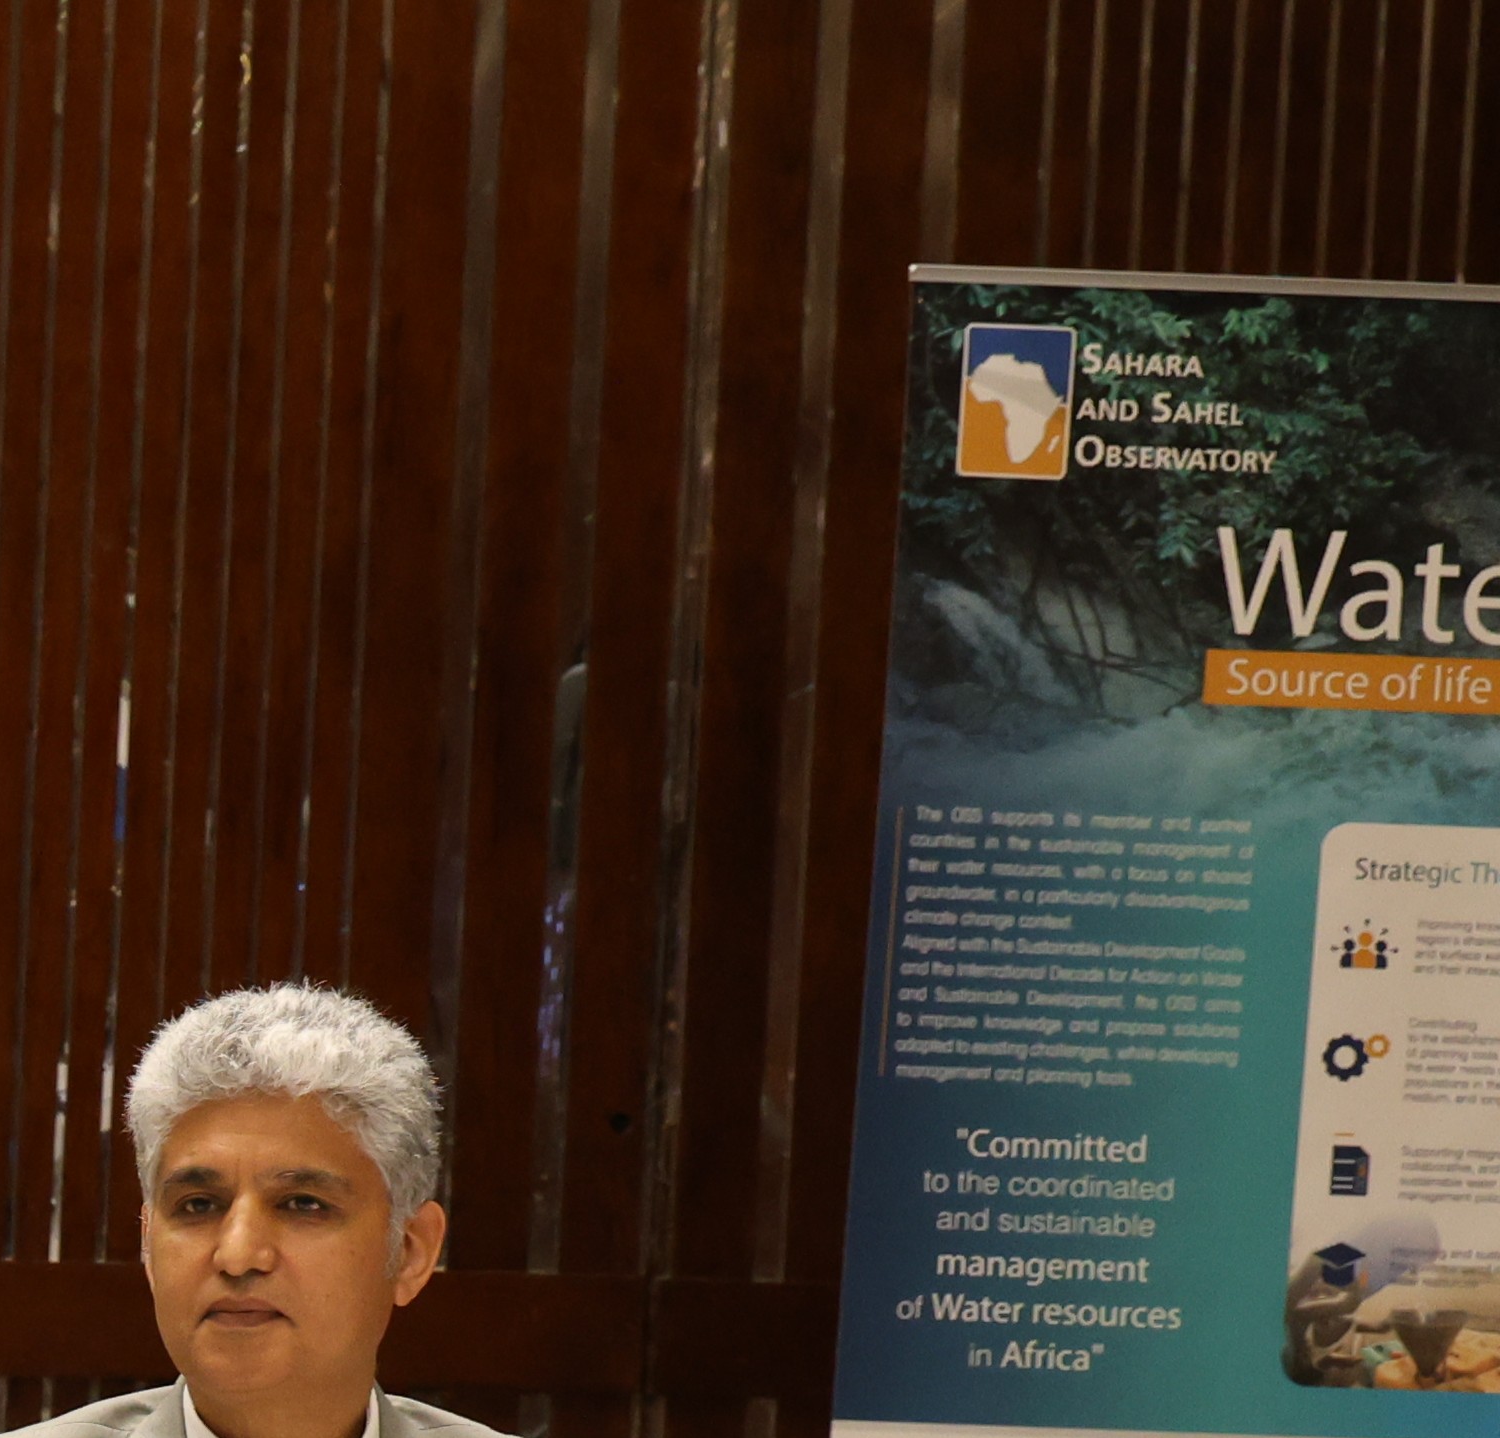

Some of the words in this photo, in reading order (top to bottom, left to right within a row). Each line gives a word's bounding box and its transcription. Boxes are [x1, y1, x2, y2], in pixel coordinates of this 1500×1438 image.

[1215, 527, 1500, 652] Wate
[1227, 658, 1369, 699] Source
[1381, 663, 1425, 700] of
[1434, 665, 1492, 704] life
[1355, 857, 1461, 889] Strategic
[1470, 861, 1500, 884] Th
[957, 1129, 1148, 1163] "Committed
[924, 1170, 950, 1193] to
[958, 1170, 1000, 1195] the
[1008, 1175, 1176, 1201] coordinated
[936, 1207, 990, 1231] and
[999, 1212, 1158, 1239] sustainable
[937, 1255, 1150, 1286] management
[896, 1295, 923, 1319] of
[932, 1293, 1024, 1323] Water
[1033, 1304, 1181, 1329] resources
[968, 1344, 992, 1366] in
[1001, 1340, 1104, 1371] Africa"
